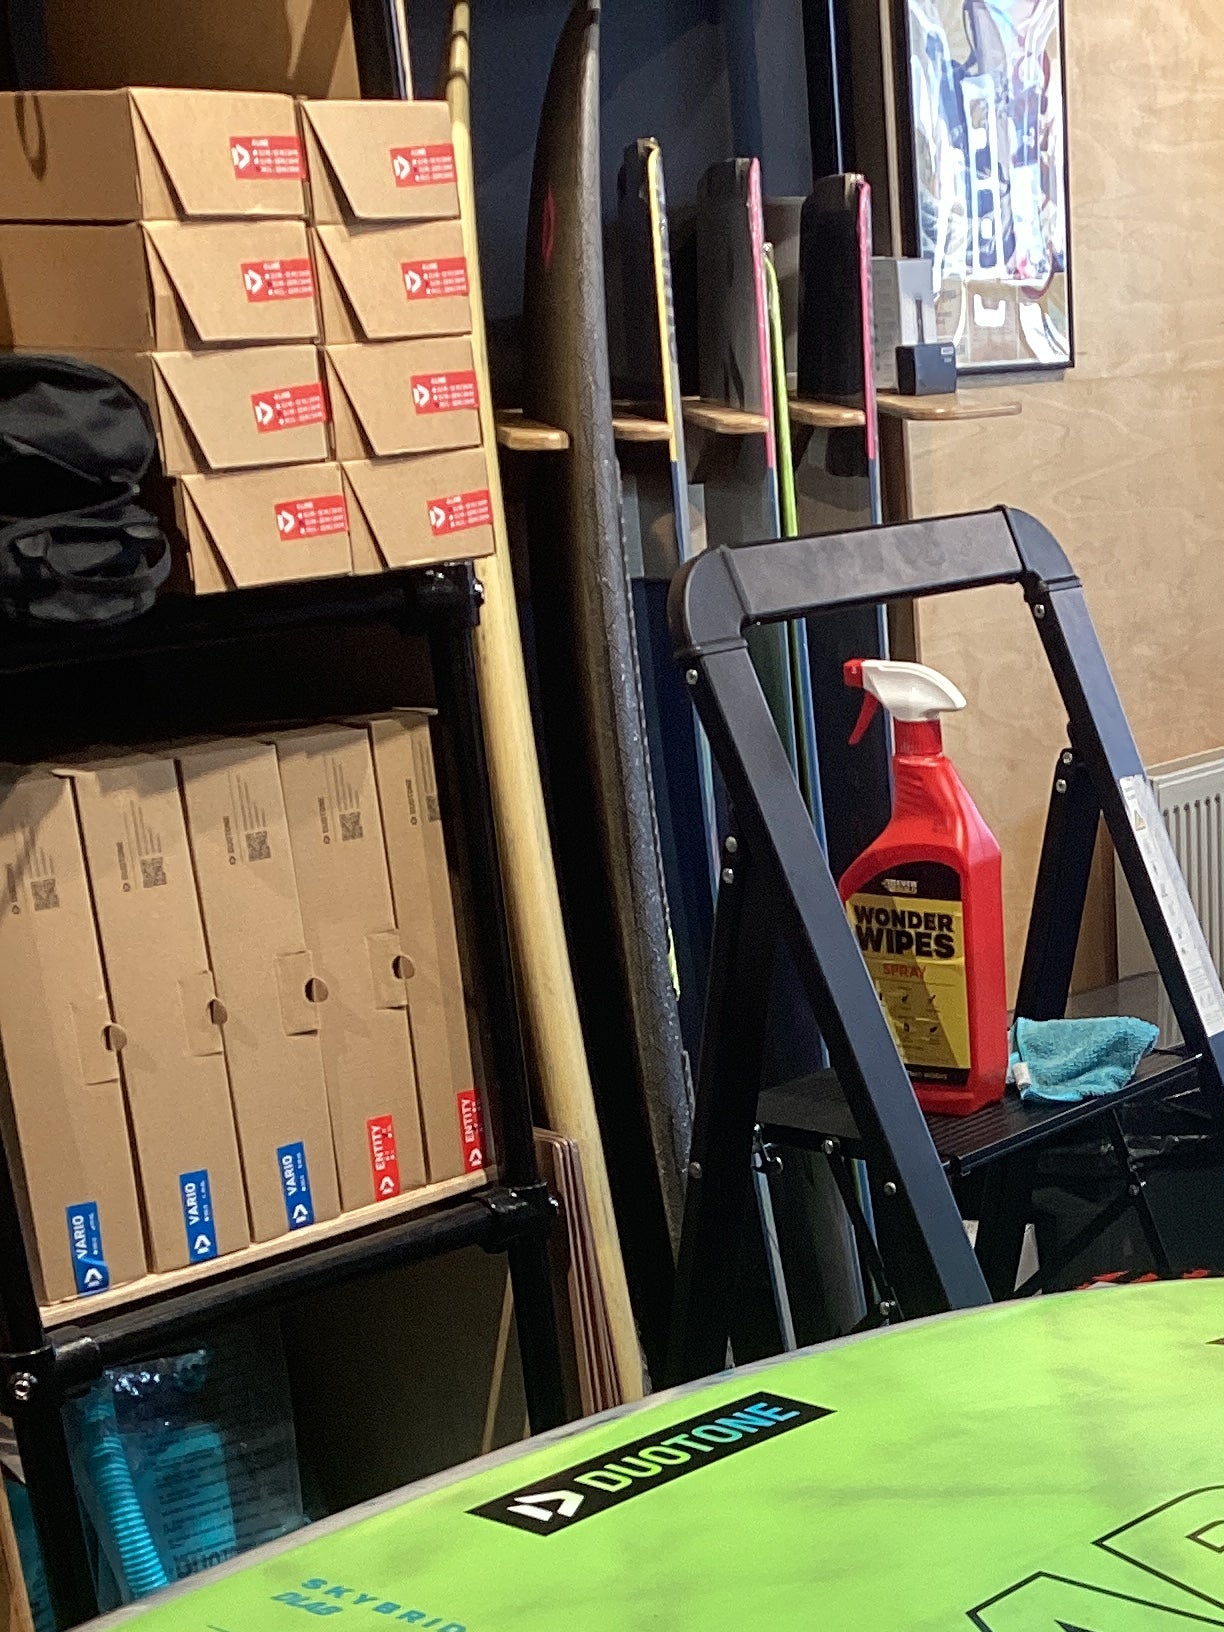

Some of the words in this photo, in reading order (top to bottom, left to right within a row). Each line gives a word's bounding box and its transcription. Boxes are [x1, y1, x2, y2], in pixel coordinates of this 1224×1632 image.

[853, 905, 954, 932] WONDER
[854, 924, 955, 959] WIPES
[883, 963, 927, 978] SPRAY
[460, 1098, 475, 1144] ENTITY
[370, 1124, 386, 1171] ENTITY
[281, 1154, 297, 1197] VARIO
[184, 1182, 199, 1226] VARIO
[71, 1215, 88, 1259] VARIO
[574, 1402, 800, 1492] DUOTONE
